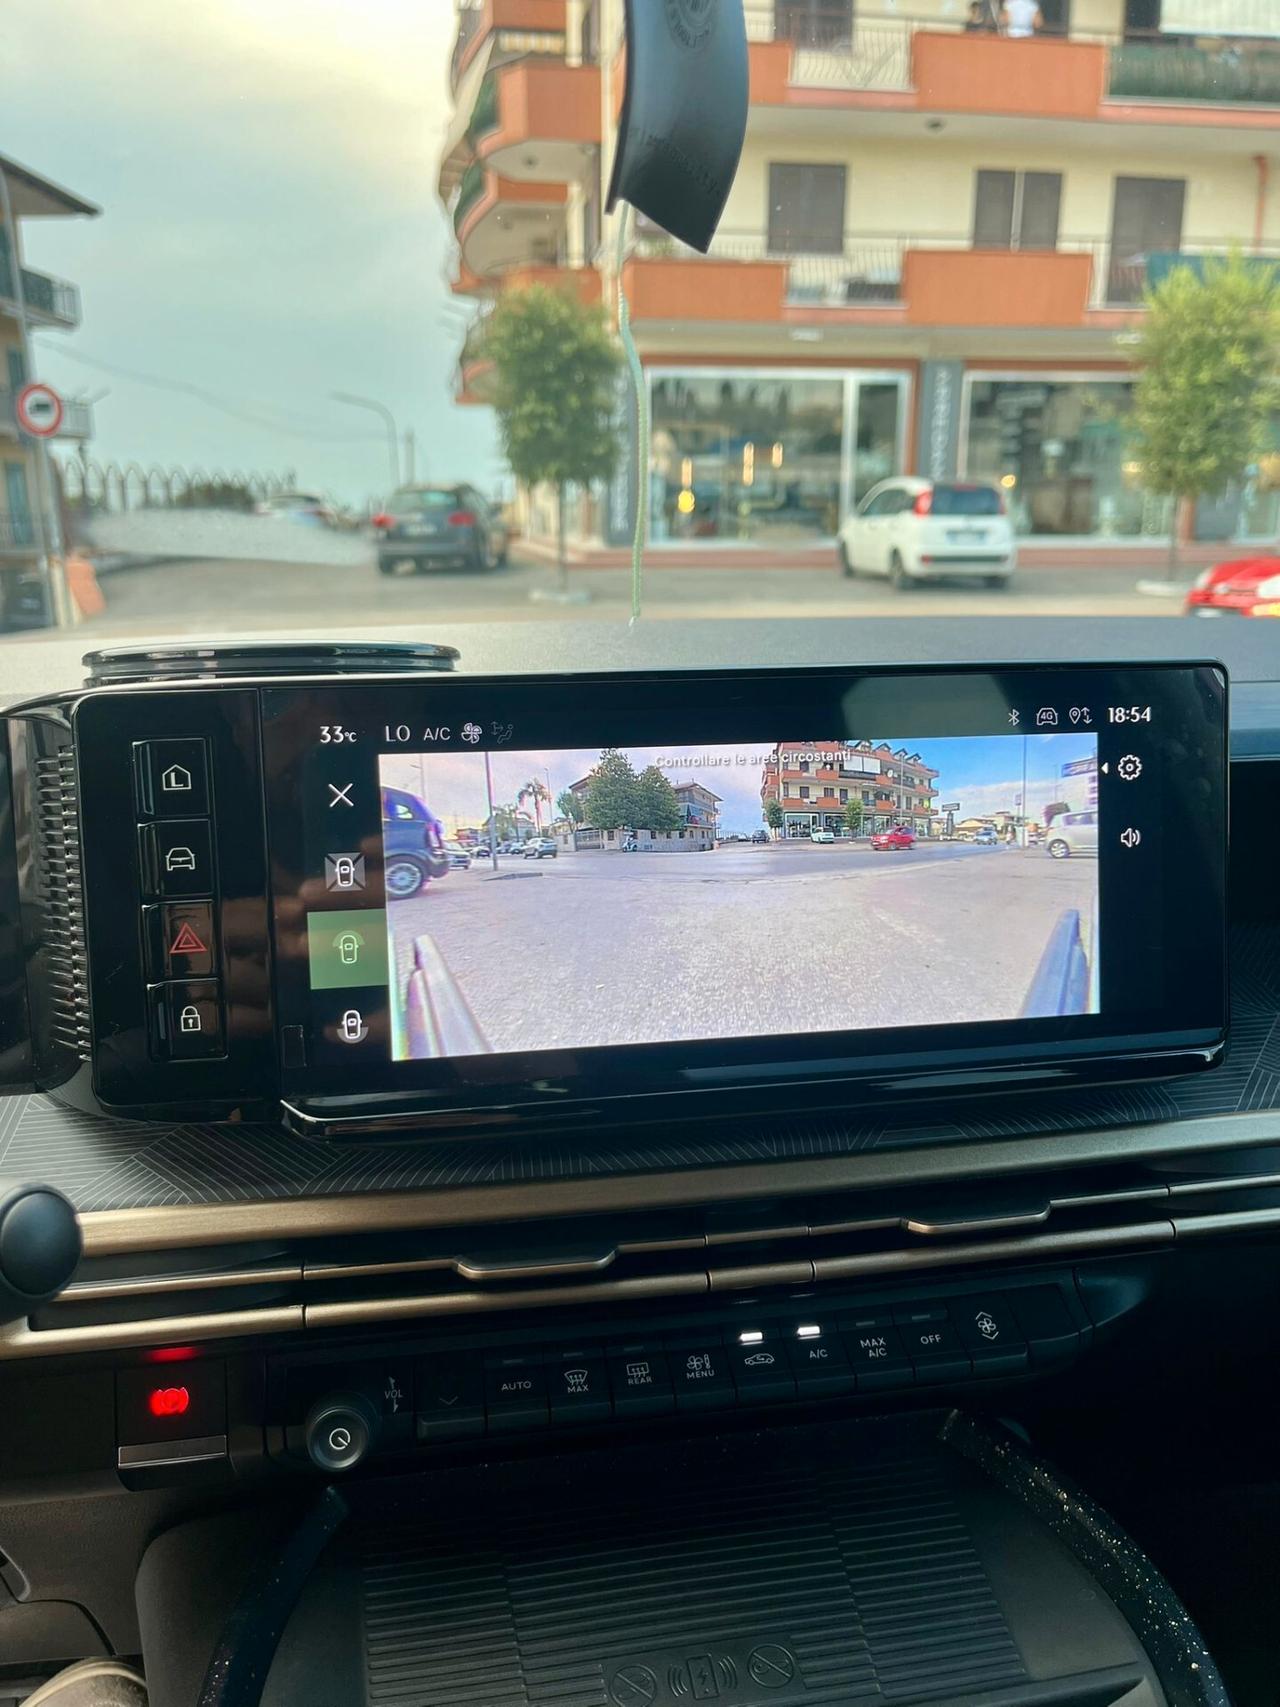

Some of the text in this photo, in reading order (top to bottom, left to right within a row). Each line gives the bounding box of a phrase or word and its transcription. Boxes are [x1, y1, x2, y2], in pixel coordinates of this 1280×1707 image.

[1108, 706, 1152, 723] 18:54
[385, 724, 411, 742] LO
[423, 727, 451, 741] A/C
[655, 749, 851, 768] Controllare le aree circostanti
[860, 1337, 887, 1348] MAX
[920, 1334, 942, 1345] OFF
[809, 1348, 828, 1359] A/C
[868, 1347, 888, 1358] A/C
[686, 1369, 715, 1379] MENU
[501, 1380, 532, 1391] AUTO
[628, 1376, 653, 1385] REAR
[384, 1389, 403, 1399] VOL
[567, 1384, 590, 1393] MAX
